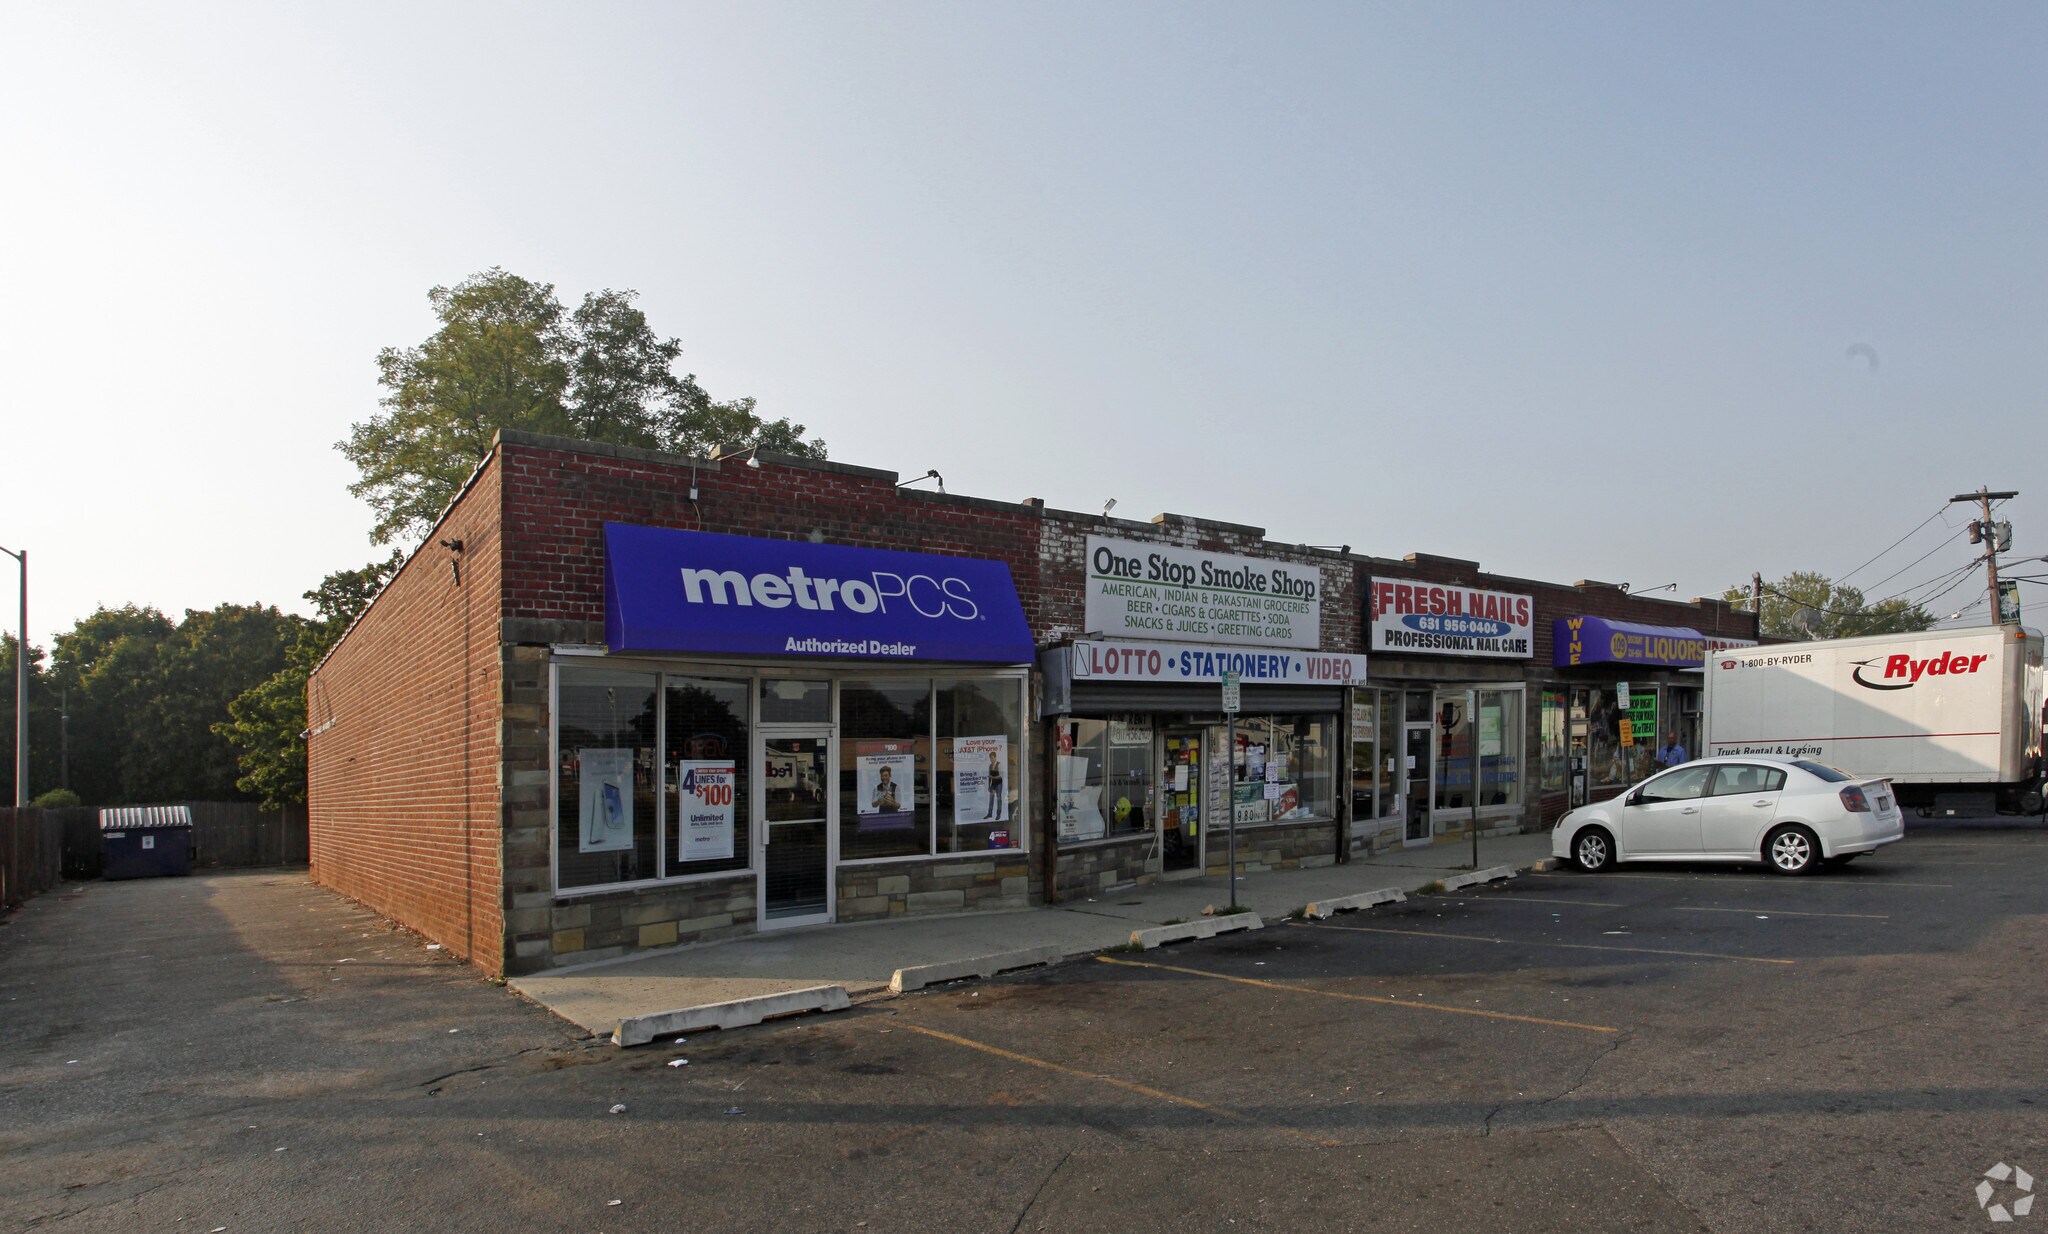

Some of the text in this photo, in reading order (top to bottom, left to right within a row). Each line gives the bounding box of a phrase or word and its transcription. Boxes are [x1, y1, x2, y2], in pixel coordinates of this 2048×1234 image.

[1093, 546, 1315, 602] One Stop Smoke Shop
[680, 565, 980, 620] metroPCS
[1101, 582, 1310, 614] AMERICAN, INDIAN & PAKASTANI GROCERIES
[1127, 600, 1290, 625] BEER CIGARS & CIGARETTES SODA
[1379, 582, 1530, 628] FRESH NAILS
[1124, 615, 1292, 639] SNACKS & JUICES GREETING CARDS
[1419, 617, 1440, 631] 631
[785, 636, 916, 656] Authorized Dealer
[1385, 629, 1527, 653] PROFESSIONAL NAIL CARE
[1567, 617, 1584, 665] WINE
[1612, 637, 1626, 653] 109
[1645, 635, 1704, 664] LIQUORS
[1091, 647, 1352, 680] LOTTO STATIONERY VIDEO
[1740, 654, 1812, 669] 1-800-BY-RYDER
[1883, 651, 1988, 683] Ryder
[1129, 713, 1147, 725] RENT
[1717, 744, 1823, 757] Truck Rental & Leasing
[682, 769, 727, 795] 4 LINES for
[696, 784, 732, 806] $100
[691, 814, 724, 822] Unlimited
[989, 831, 996, 841] 4
